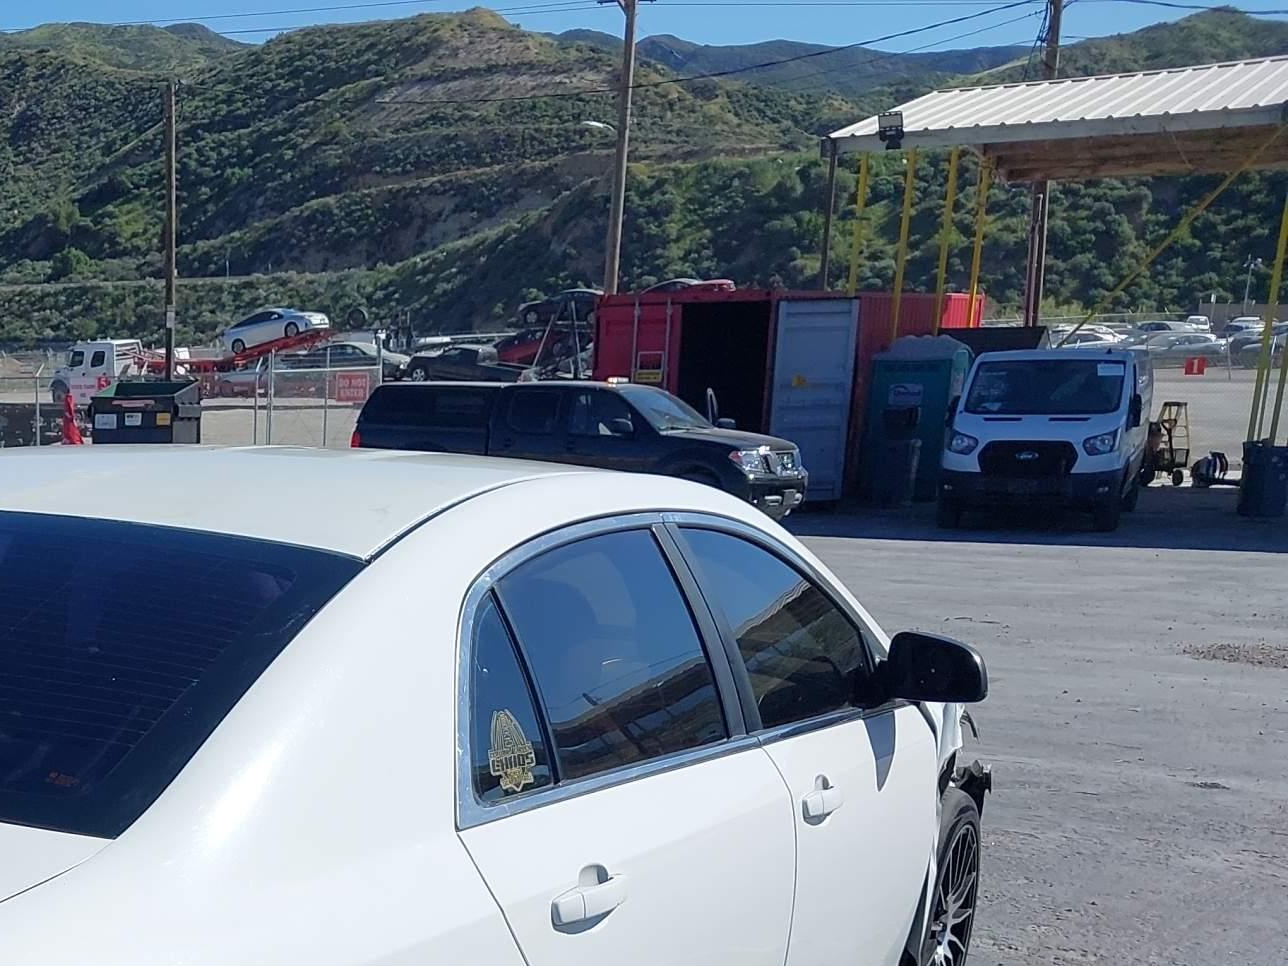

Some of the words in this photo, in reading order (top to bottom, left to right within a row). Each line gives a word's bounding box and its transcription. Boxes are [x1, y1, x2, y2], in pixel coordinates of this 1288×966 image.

[339, 378, 349, 388] DO
[351, 377, 367, 388] NOT
[339, 388, 364, 398] ENTER
